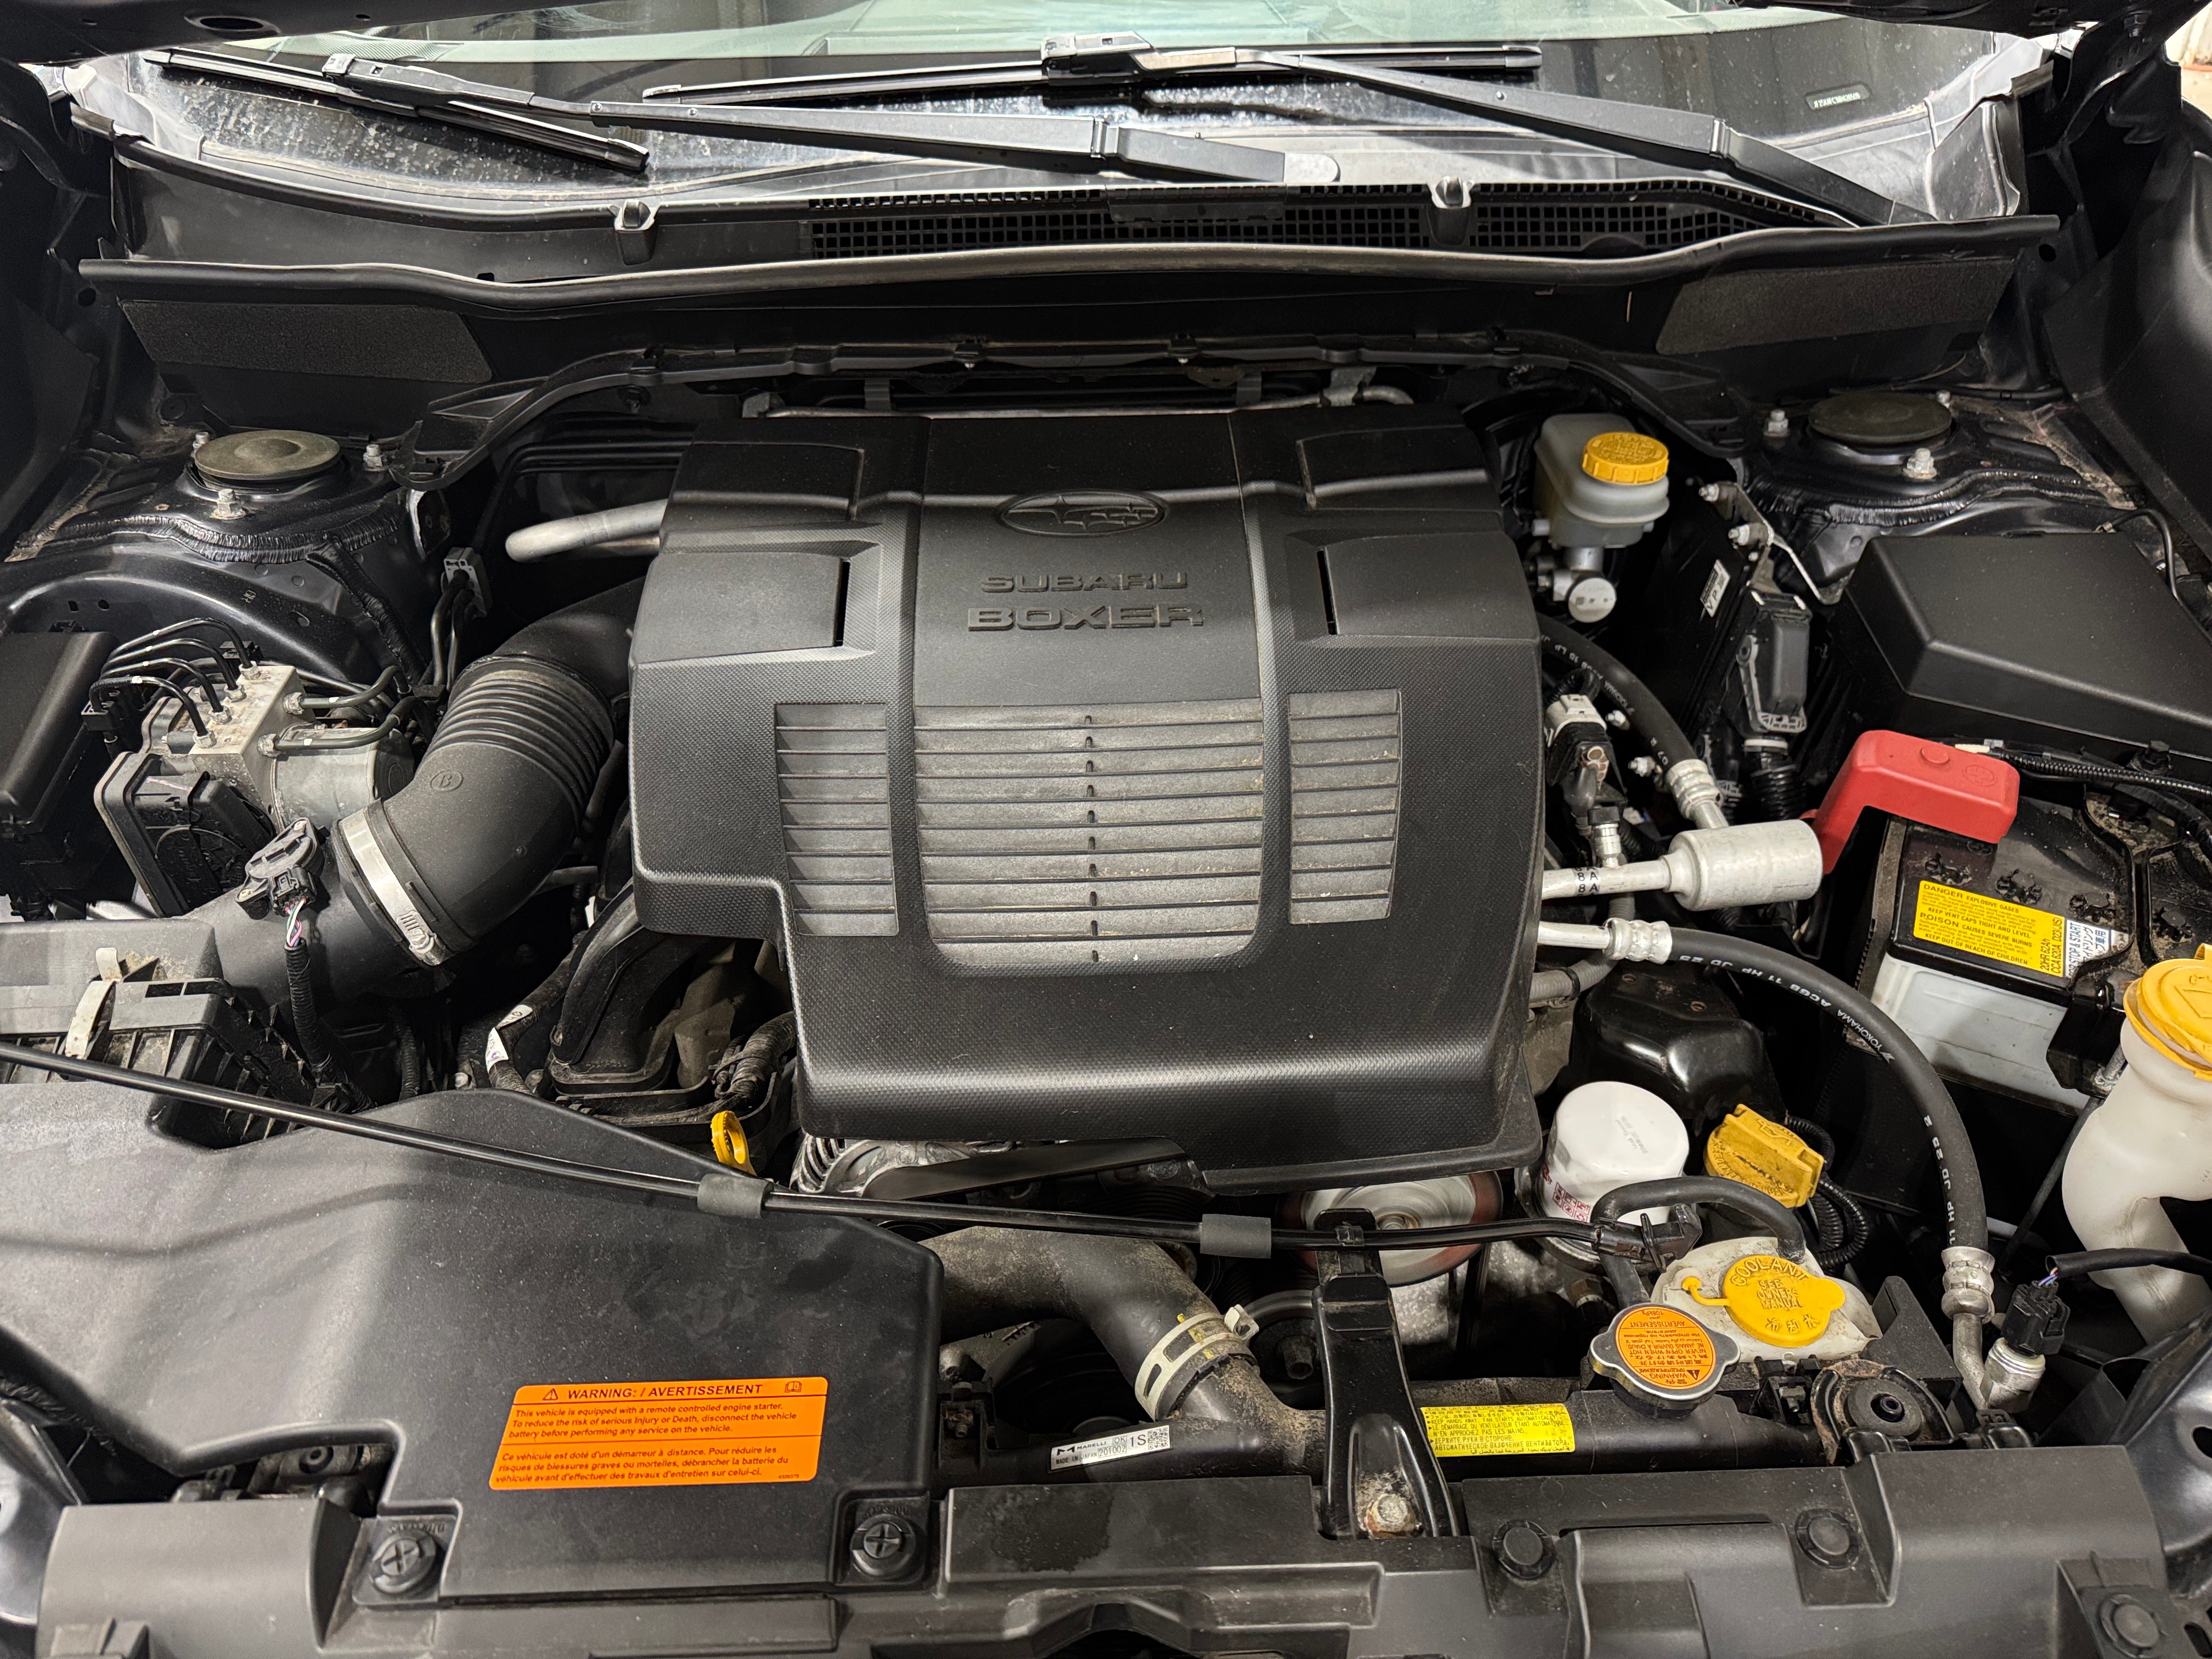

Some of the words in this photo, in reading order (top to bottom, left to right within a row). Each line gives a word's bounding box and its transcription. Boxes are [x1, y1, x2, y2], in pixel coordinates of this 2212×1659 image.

[981, 572, 1188, 592] SUBARU
[968, 605, 1204, 631] BOXER
[1577, 872, 1585, 881] 8
[1590, 872, 1598, 881] A
[1578, 884, 1585, 893] 8
[1589, 883, 1598, 892] A
[1923, 883, 1963, 899] DANGER
[1966, 895, 1997, 907] EXPLOSIVE
[1999, 904, 2019, 913] GASES
[1920, 912, 1959, 927] POISON
[1962, 924, 1985, 935] CAUSES
[1988, 931, 2009, 941] SEVERE
[1961, 916, 1977, 924] CAPS
[1979, 920, 1995, 929] TIGHT
[2012, 929, 2030, 938] LEVEL
[2069, 922, 2081, 943] START
[1925, 933, 1940, 941] KEEP
[1965, 943, 1985, 953] REACH
[1996, 952, 2027, 965] CHILDREN
[2069, 947, 2081, 964] STOP
[1711, 959, 1733, 967] JD
[2051, 961, 2061, 974] CCA
[1741, 968, 1763, 977] HP
[1768, 975, 1782, 984] 11
[1790, 984, 1832, 1007] AC6B
[1837, 1009, 1882, 1052] YOKOHAMA
[1932, 1137, 1944, 1160] 25
[1941, 1168, 1951, 1189] JD
[1947, 1201, 1955, 1222] HP
[1730, 1258, 1809, 1286] COOLANT
[1758, 1279, 1784, 1290] SEE
[1757, 1288, 1799, 1300] OWNERS
[1761, 1297, 1803, 1310] MANUAL
[568, 1388, 636, 1399] WARNING:
[648, 1384, 763, 1397] AVERTISSEMENT
[577, 1408, 617, 1416] equipped
[678, 1404, 721, 1412] controlled
[702, 1414, 749, 1422] disconnect
[509, 1431, 538, 1439] battery
[541, 1429, 568, 1437] before
[570, 1428, 617, 1437] performing
[1076, 1441, 1106, 1451] MARELLI
[1114, 1436, 1126, 1444] OK
[1098, 1445, 1126, 1457] 201002
[1433, 1443, 1488, 1451] АВТОМАТИЧЕСКОЕ
[517, 1452, 552, 1460] véhicule
[499, 1464, 531, 1472] risques
[547, 1462, 589, 1470] blessures
[591, 1462, 620, 1470] graves
[636, 1459, 679, 1469] mortelles,
[742, 1457, 775, 1465] batterie
[628, 1471, 660, 1480] travaux
